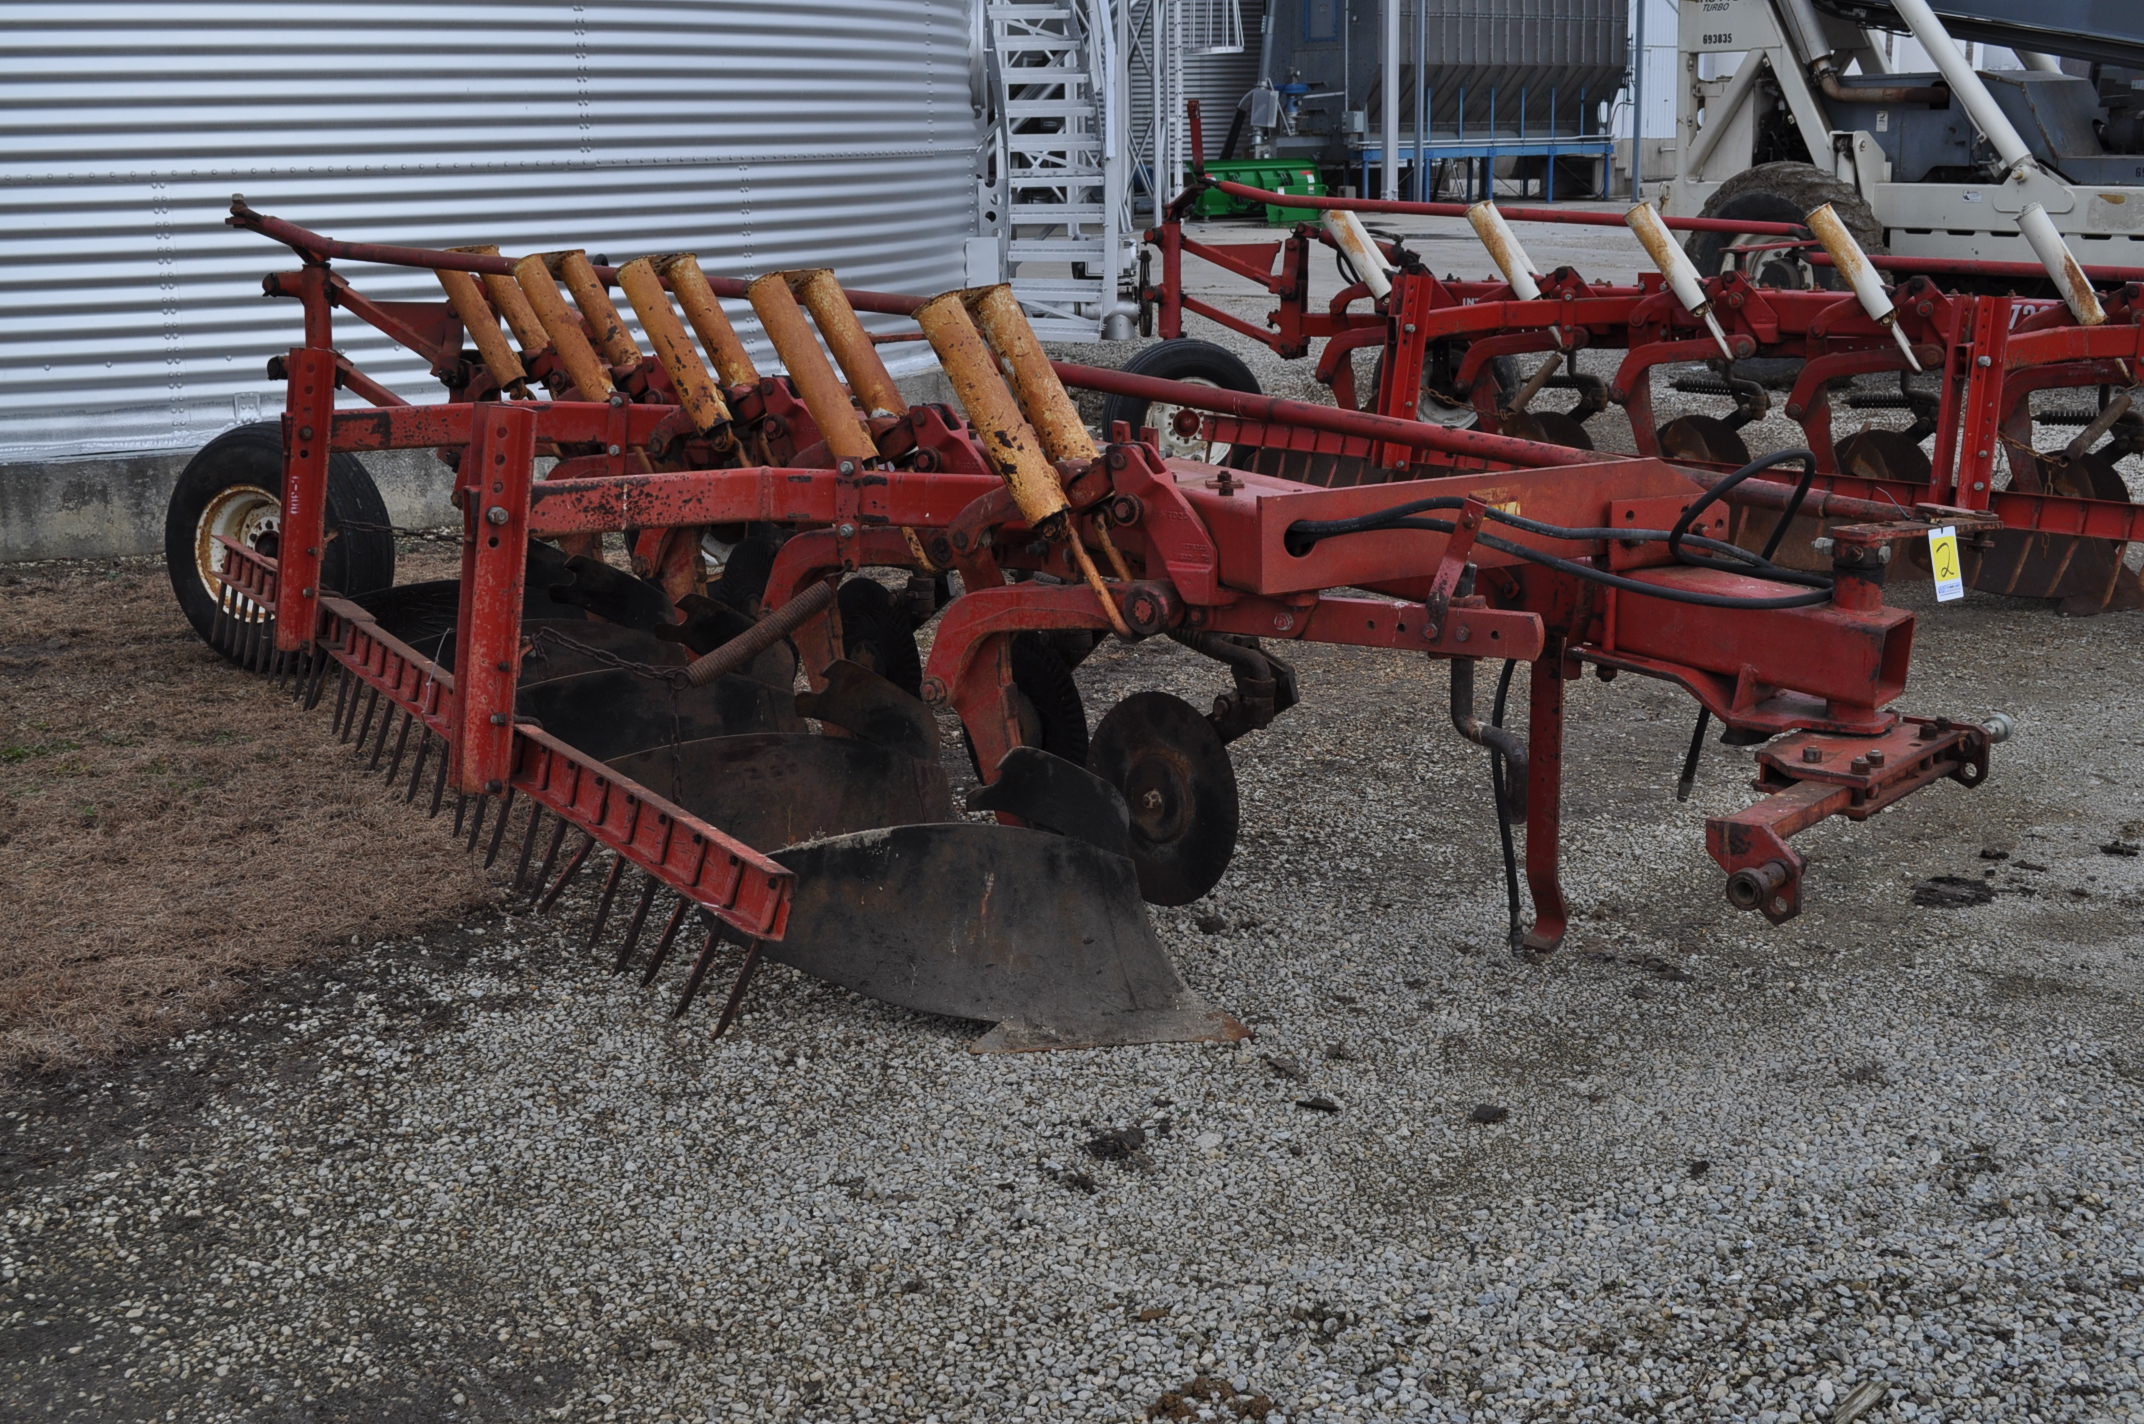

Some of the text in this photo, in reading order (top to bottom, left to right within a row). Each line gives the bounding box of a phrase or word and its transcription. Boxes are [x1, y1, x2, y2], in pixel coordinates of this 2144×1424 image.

[1703, 3, 1730, 12] TURBO
[1703, 33, 1733, 45] 693835
[1936, 542, 1955, 578] 2
